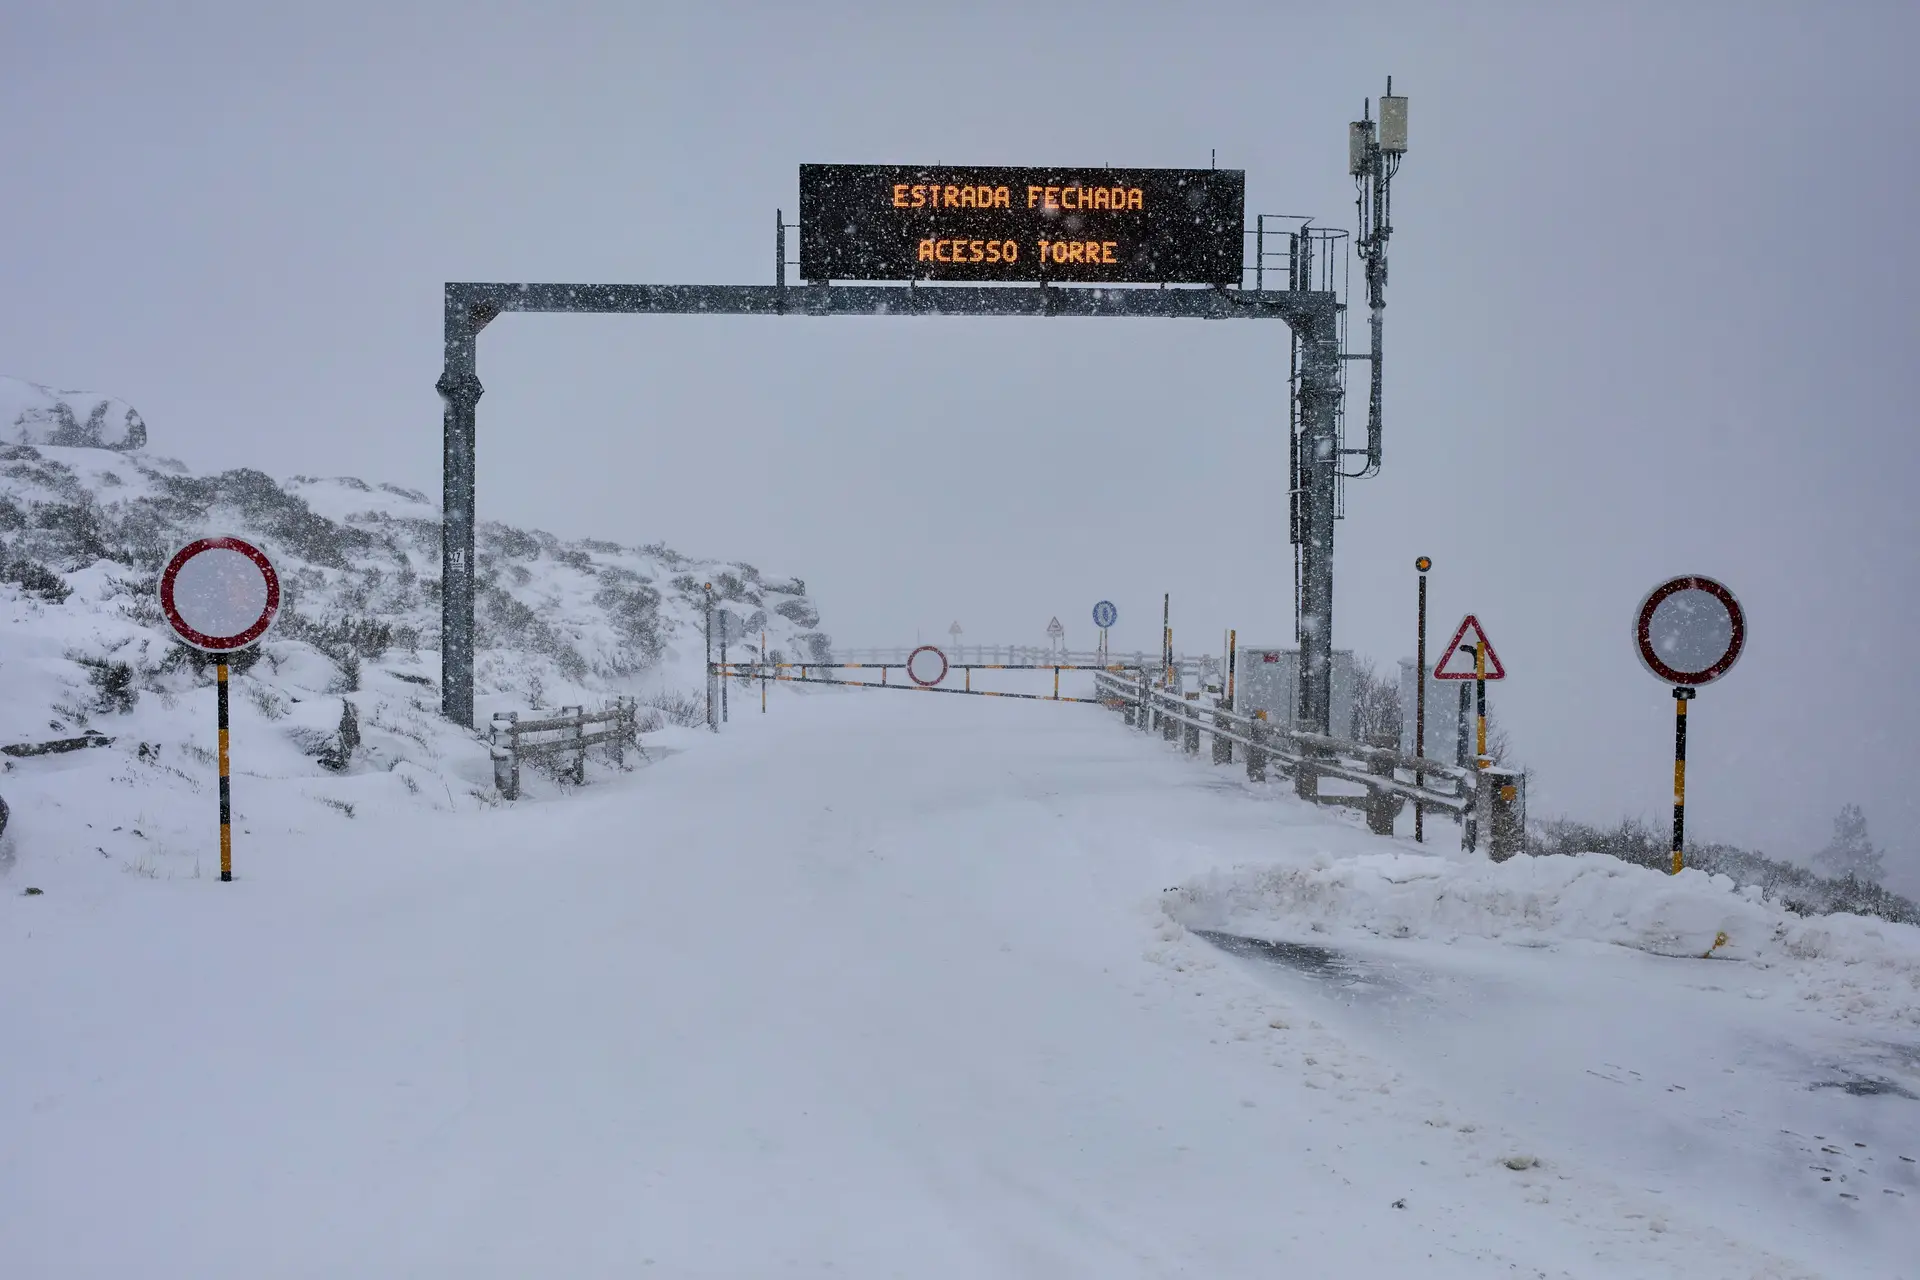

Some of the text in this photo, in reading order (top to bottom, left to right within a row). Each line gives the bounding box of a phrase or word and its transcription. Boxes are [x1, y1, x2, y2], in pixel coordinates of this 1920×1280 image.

[893, 184, 1144, 210] ESTRADA FECHADA
[918, 239, 1117, 265] ACESSO TORRE
